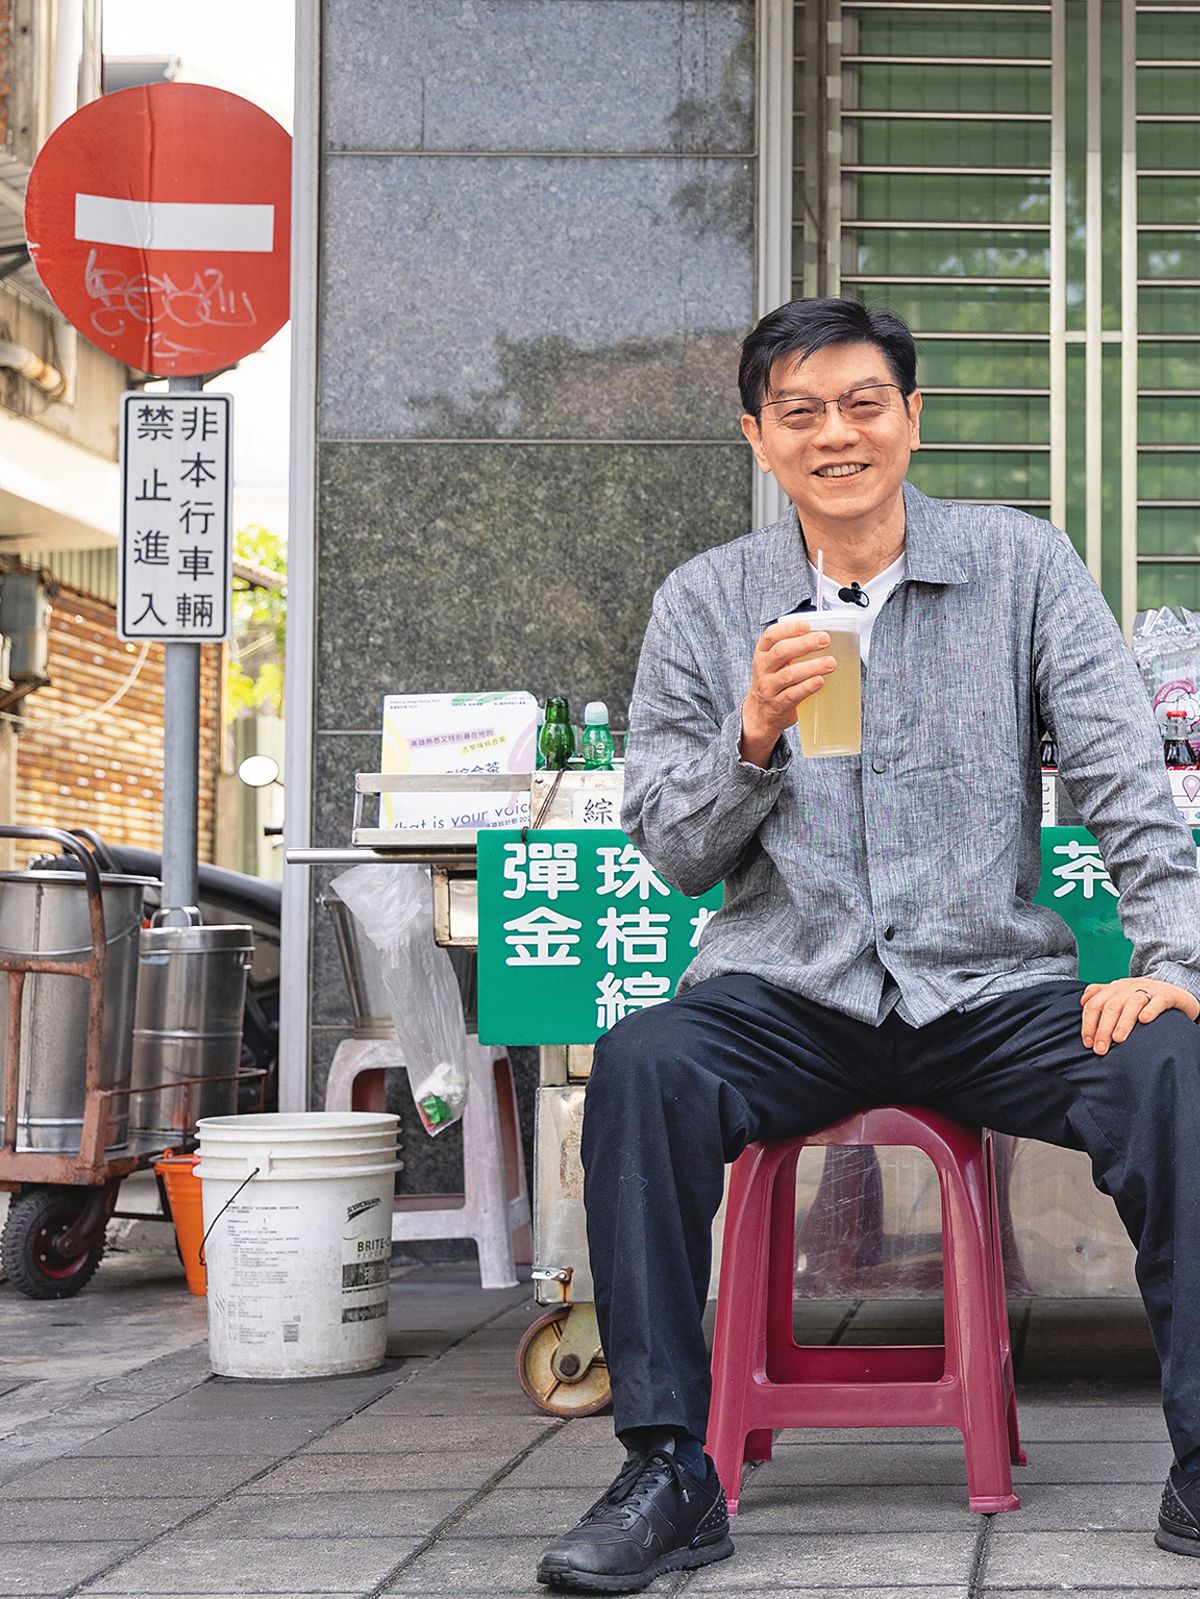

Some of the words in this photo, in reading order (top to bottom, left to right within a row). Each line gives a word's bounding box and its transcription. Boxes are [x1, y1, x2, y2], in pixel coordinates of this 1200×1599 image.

[132, 405, 175, 628] 禁止進入
[176, 405, 219, 629] 非本行車輛
[433, 816, 444, 829] is
[451, 811, 488, 828] your
[495, 800, 531, 817] voic
